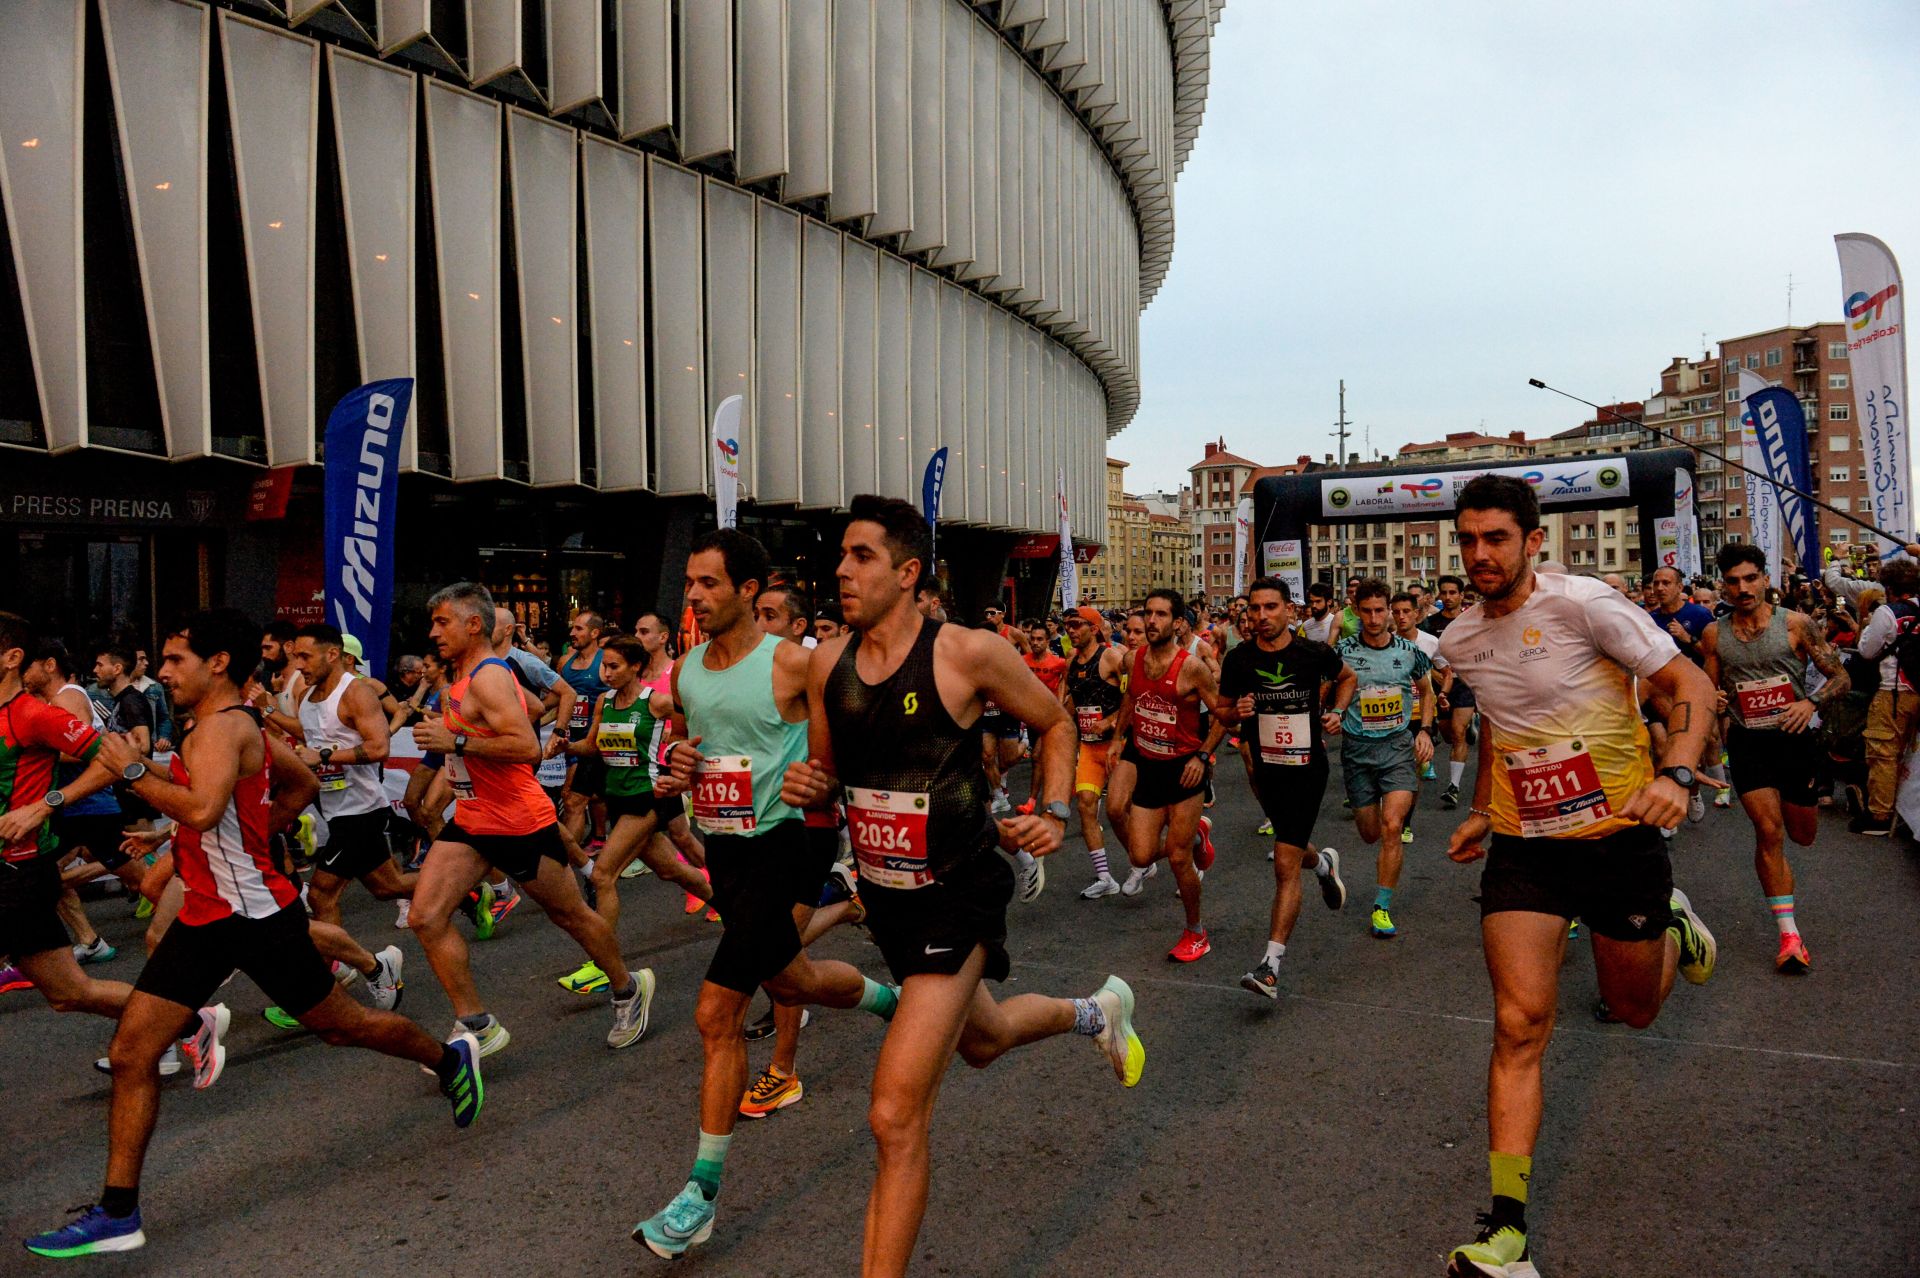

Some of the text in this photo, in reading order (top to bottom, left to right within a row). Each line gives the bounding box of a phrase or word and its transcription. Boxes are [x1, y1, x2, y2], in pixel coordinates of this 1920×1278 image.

[13, 495, 81, 515] PRESS
[89, 498, 173, 519] PRENSA
[1356, 498, 1394, 506] LABORAL
[1076, 548, 1089, 561] A
[1518, 646, 1549, 659] GEROA
[1364, 700, 1400, 714] 10192
[1747, 691, 1786, 709] 2244
[1140, 721, 1168, 739] 2334
[1275, 731, 1293, 744] 53
[599, 738, 632, 748] 10177
[696, 781, 740, 802] 2196
[1520, 769, 1582, 802] 2211
[856, 821, 912, 852] 2034
